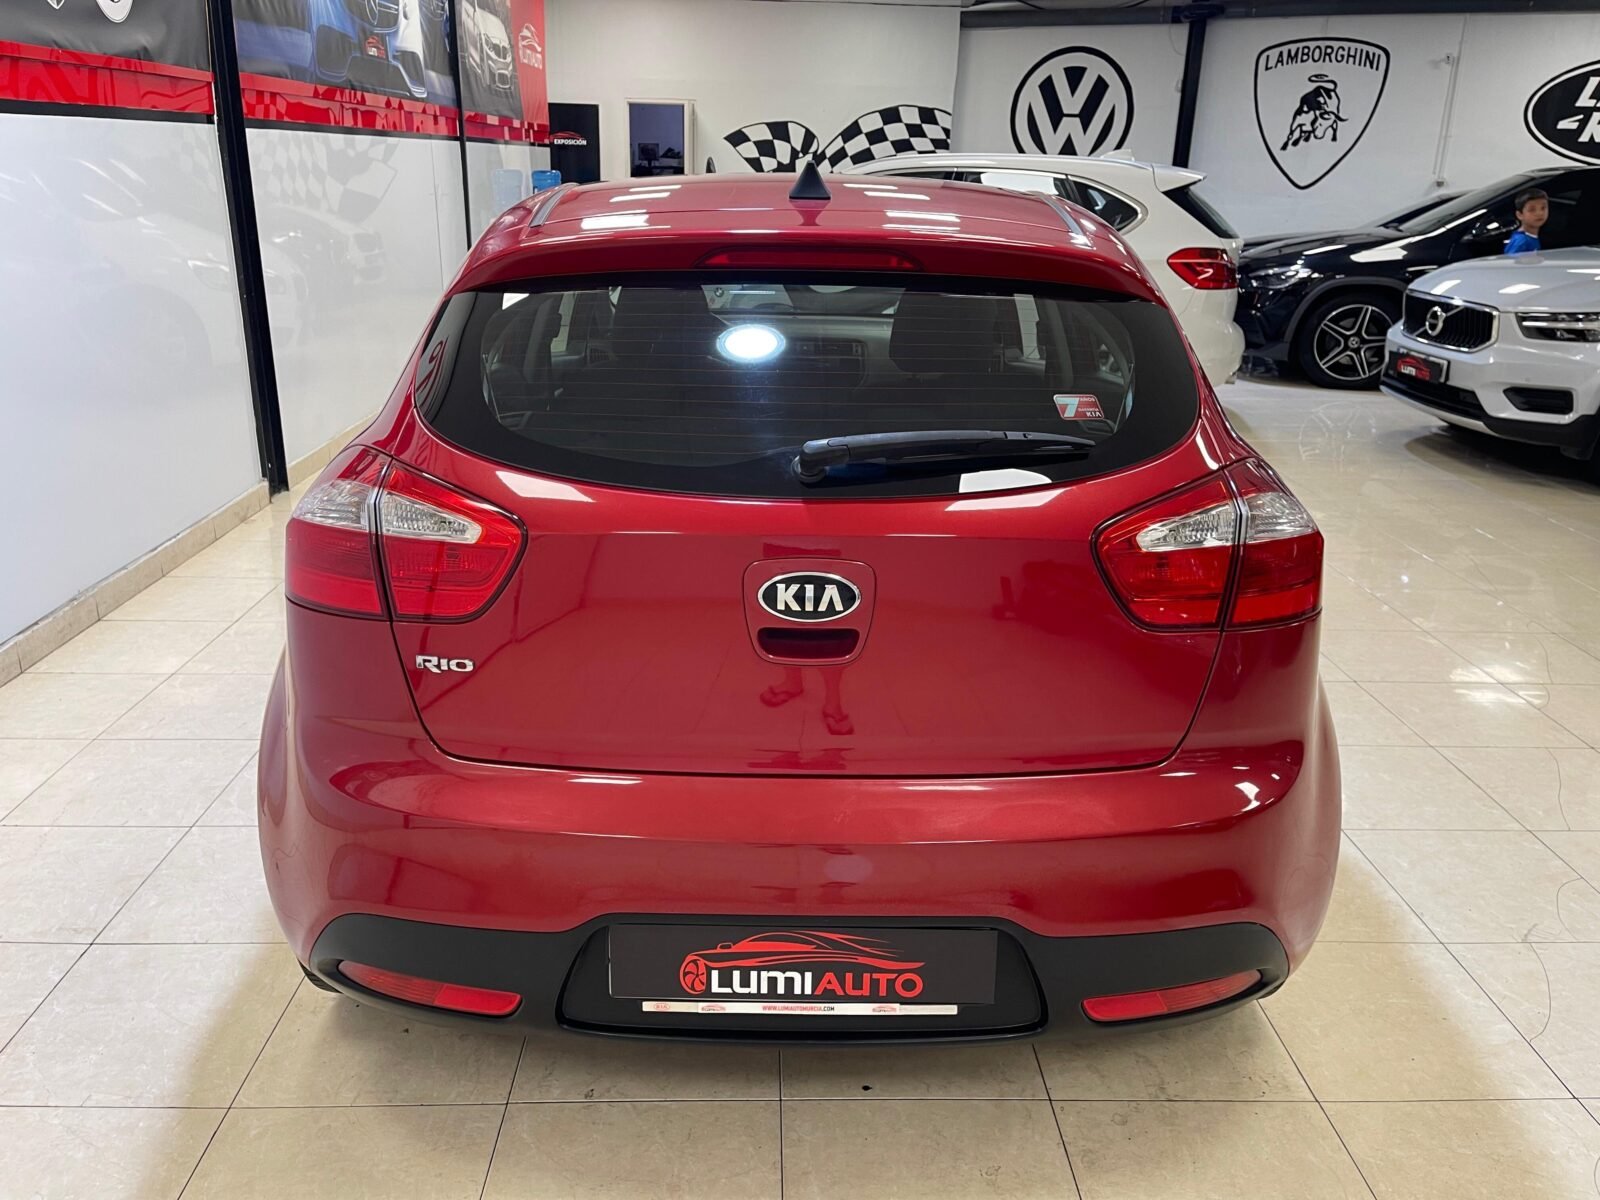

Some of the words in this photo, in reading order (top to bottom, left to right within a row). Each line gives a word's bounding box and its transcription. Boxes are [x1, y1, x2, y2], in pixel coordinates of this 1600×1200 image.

[1264, 45, 1381, 72] LAMBORGHINI
[1056, 397, 1079, 417] 7
[776, 583, 844, 611] KIA
[415, 655, 474, 673] RIO
